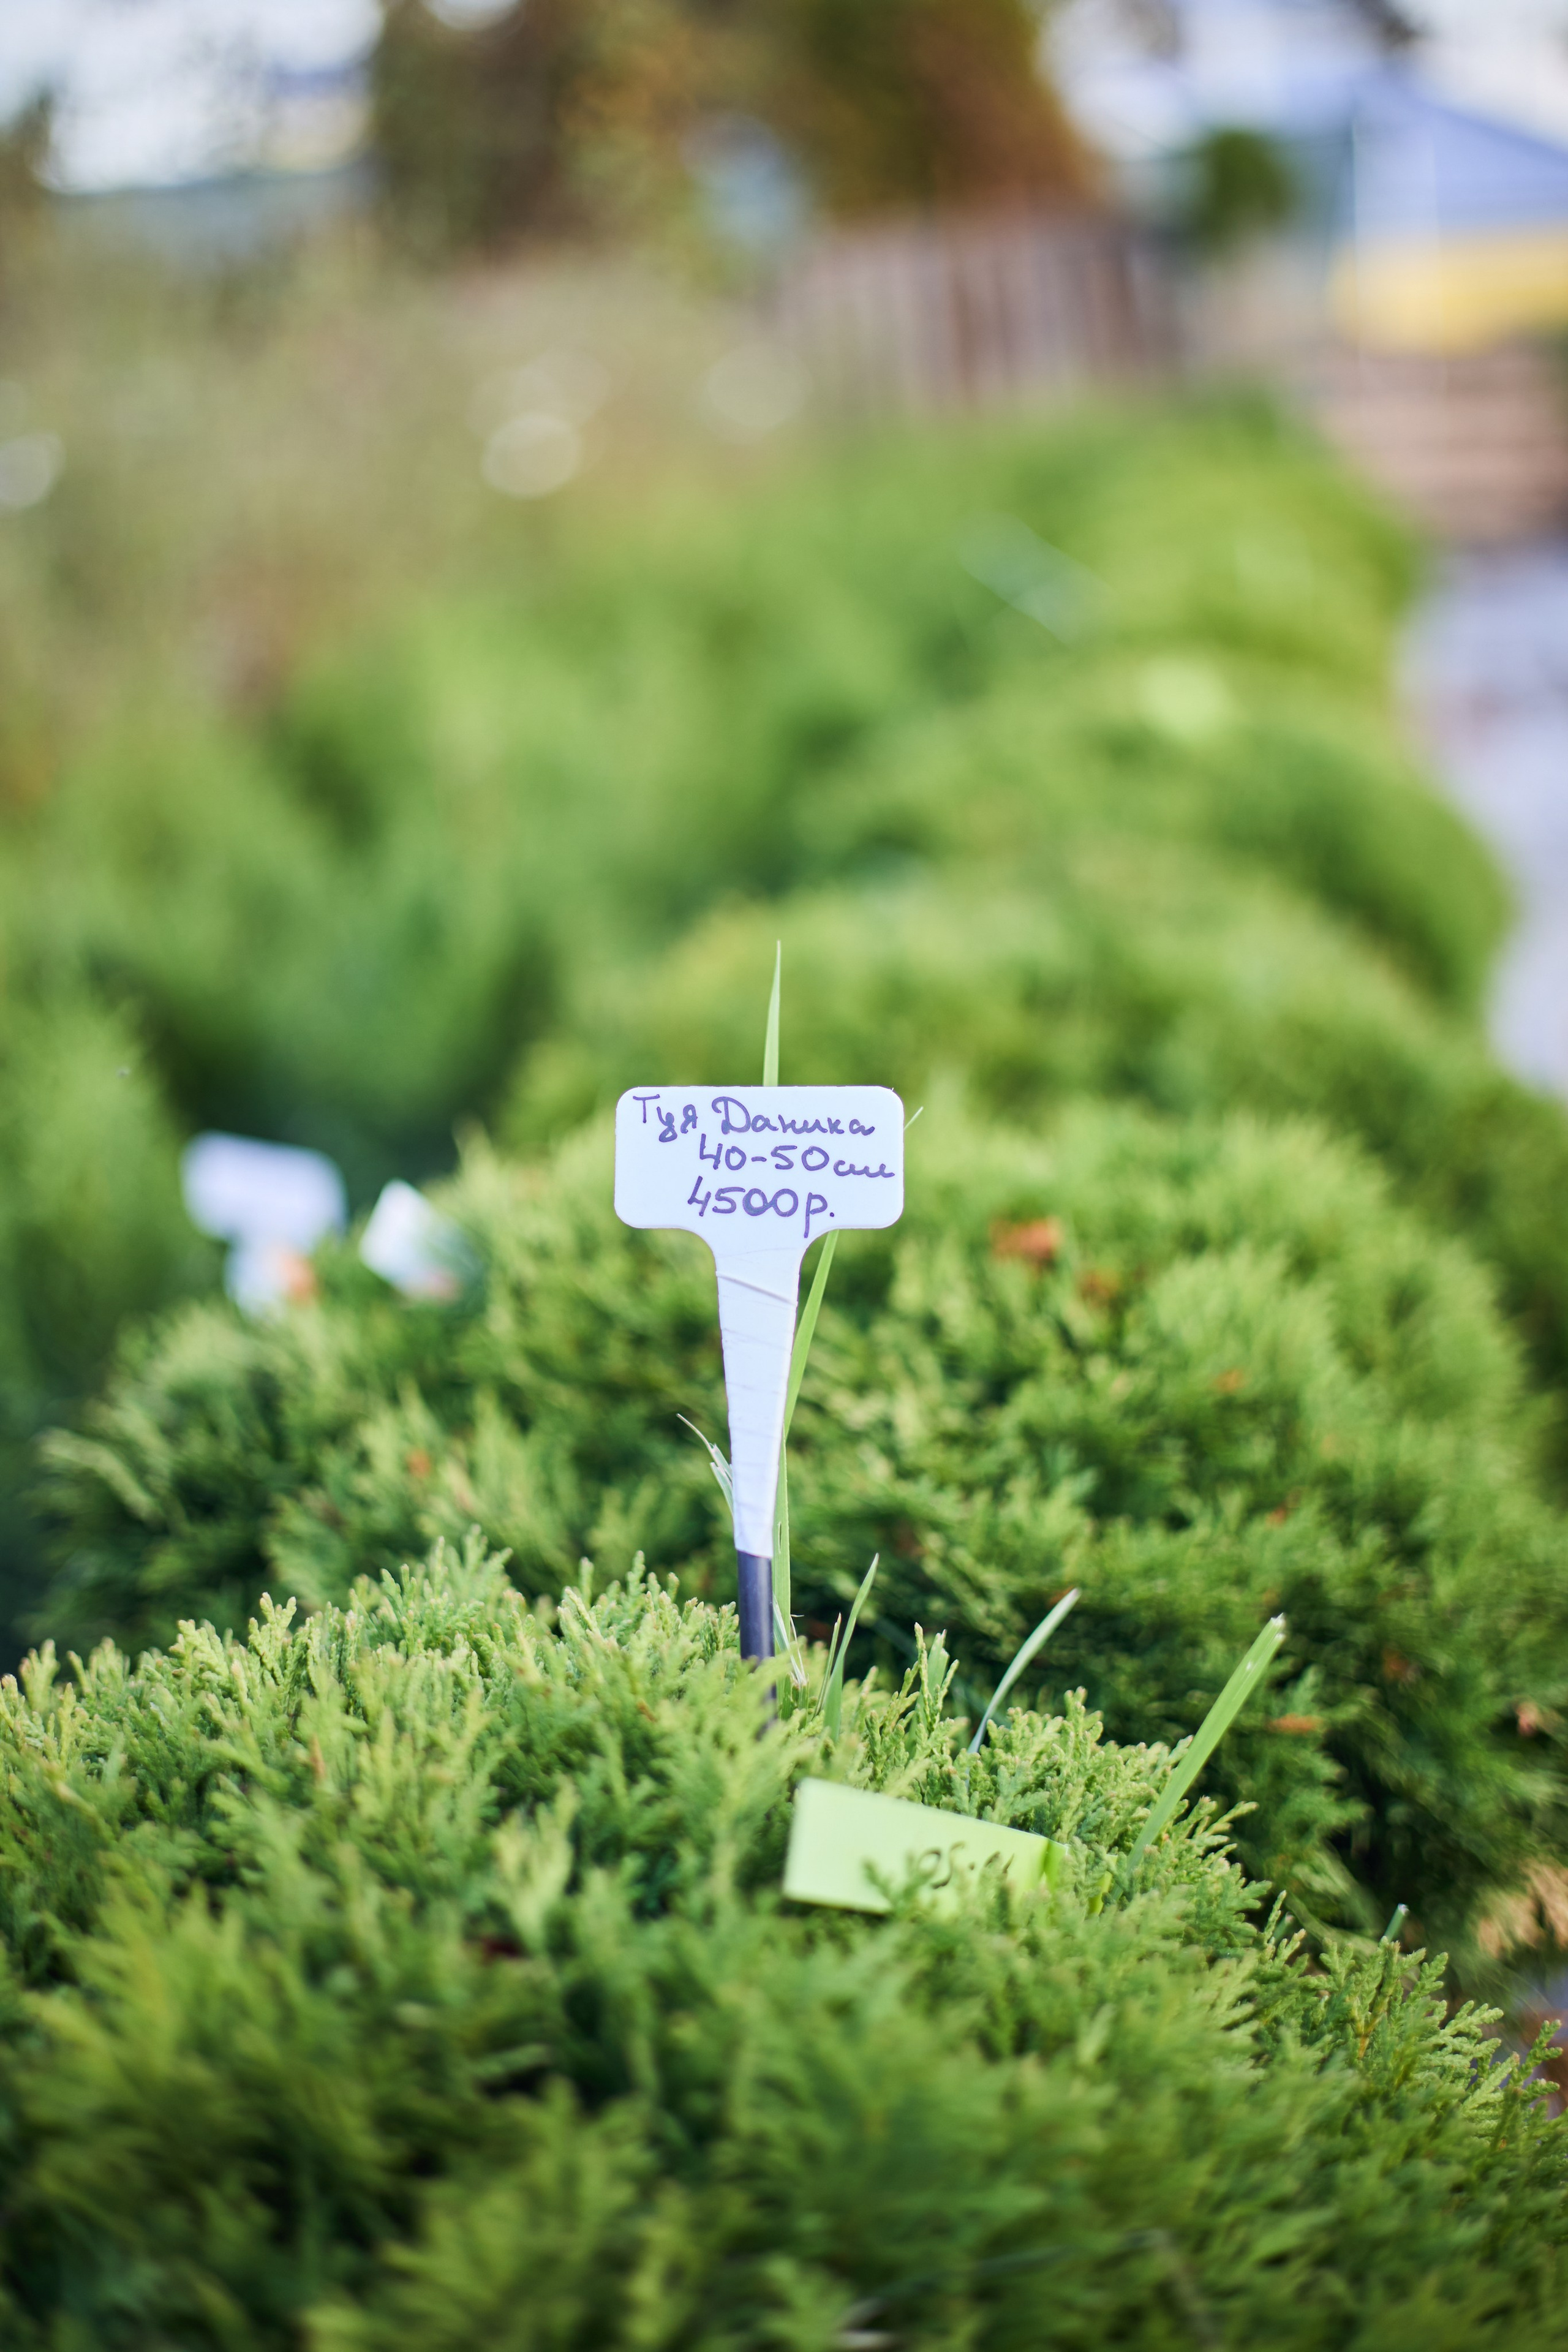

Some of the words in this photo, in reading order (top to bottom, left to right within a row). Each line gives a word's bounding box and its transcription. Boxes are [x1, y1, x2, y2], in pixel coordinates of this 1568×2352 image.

[632, 1093, 698, 1143] Туя
[711, 1096, 876, 1136] Даника
[687, 1175, 835, 1238] 4500р.
